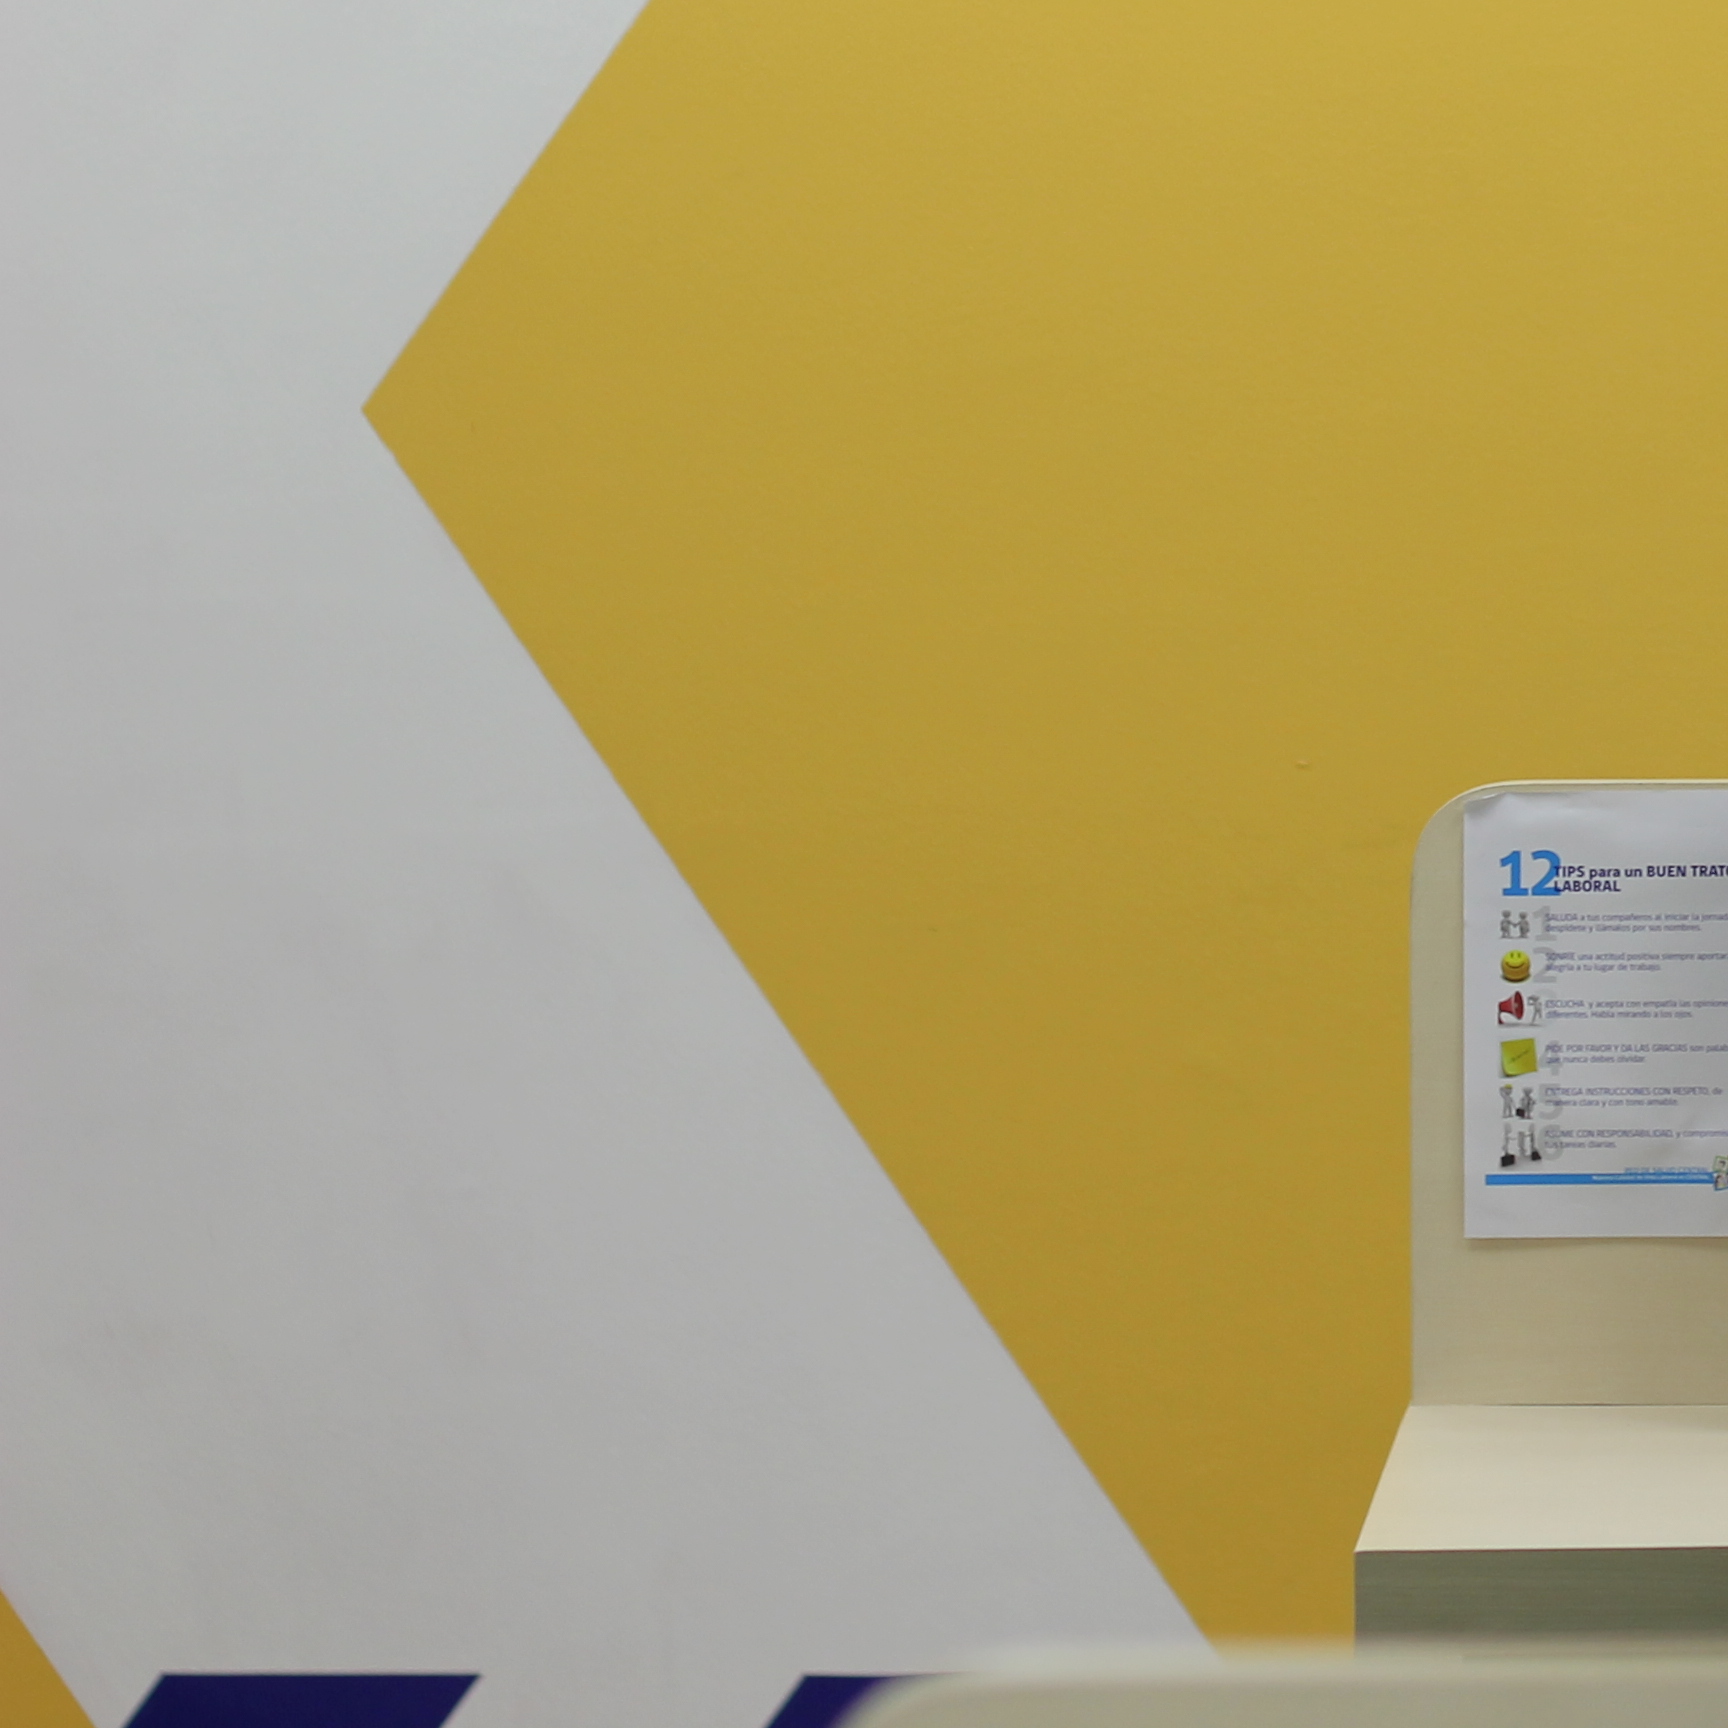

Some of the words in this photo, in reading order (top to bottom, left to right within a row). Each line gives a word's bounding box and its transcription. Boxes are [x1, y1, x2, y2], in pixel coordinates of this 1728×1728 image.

[1500, 850, 1561, 896] 12
[1554, 866, 1585, 877] TIPS
[1589, 867, 1621, 879] para
[1625, 868, 1642, 877] un
[1646, 866, 1687, 877] BUEN
[1554, 880, 1621, 892] LABORAL
